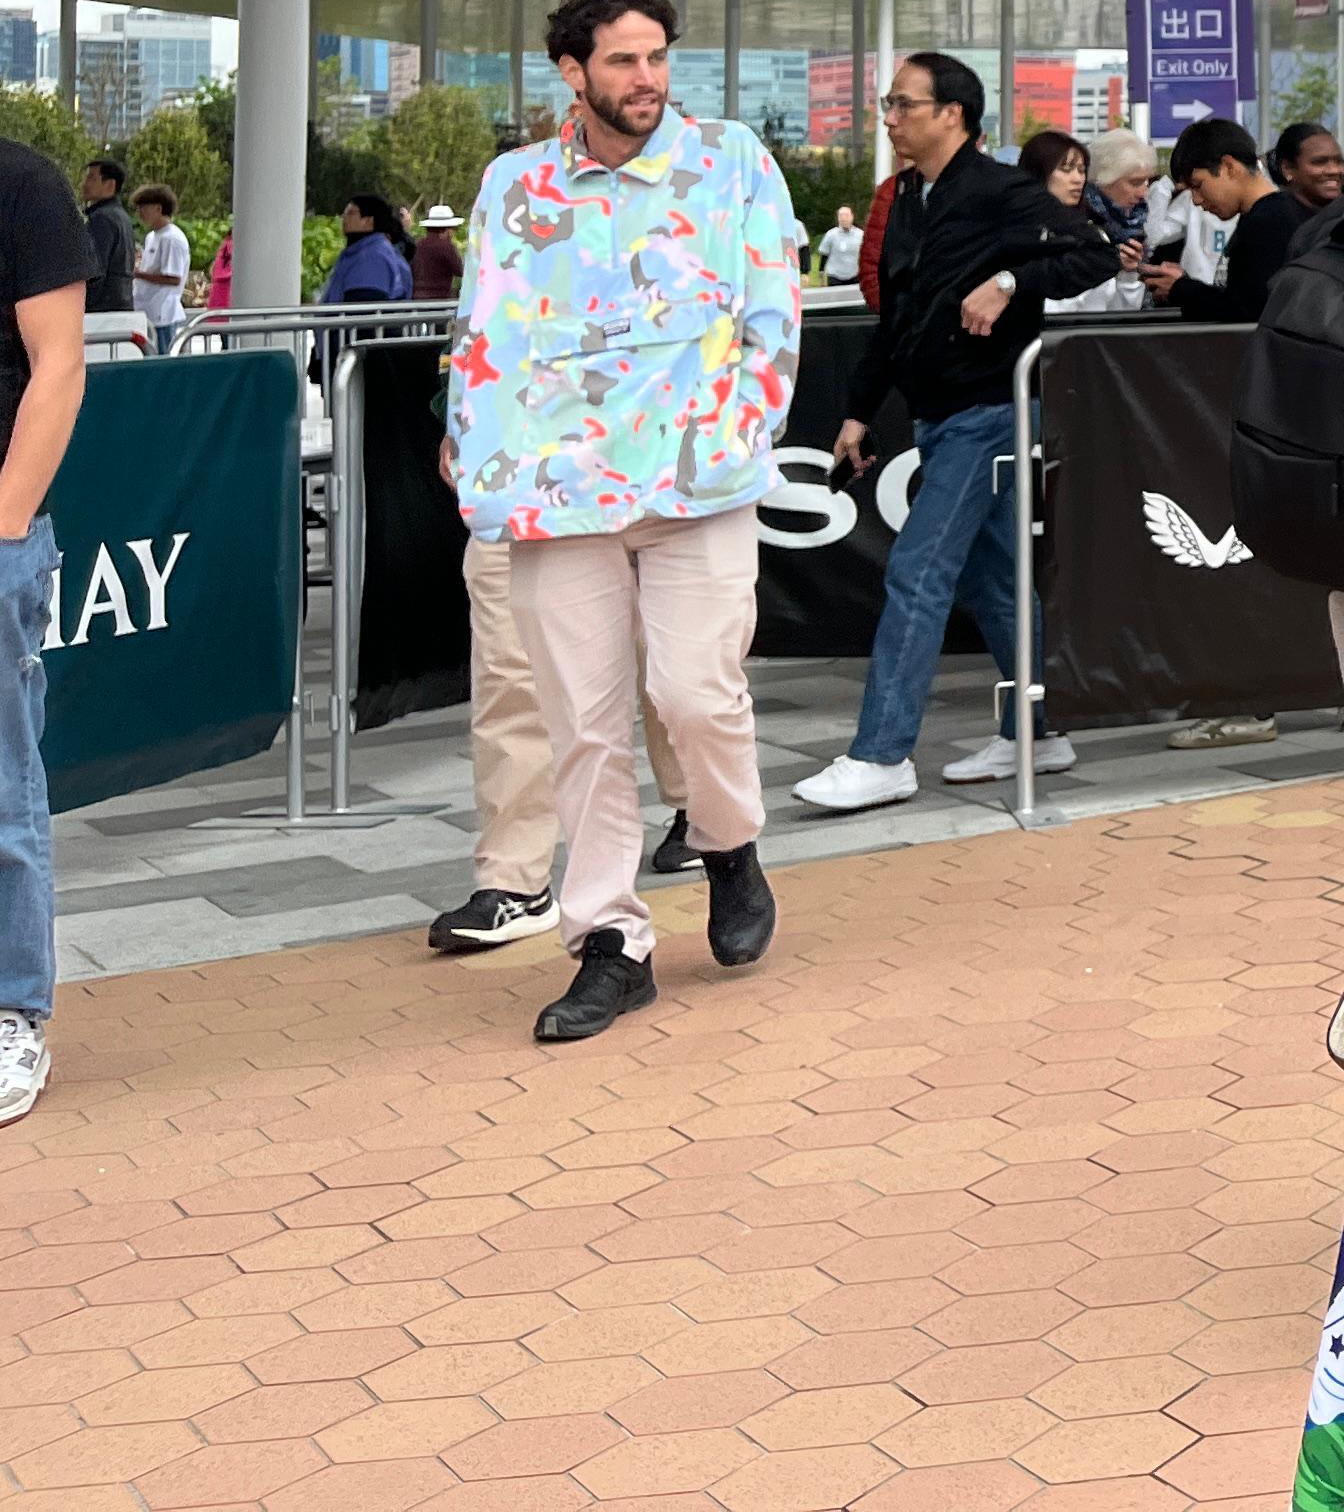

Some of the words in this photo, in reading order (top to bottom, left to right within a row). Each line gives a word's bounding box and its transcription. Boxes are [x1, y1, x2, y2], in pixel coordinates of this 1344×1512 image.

[1160, 7, 1223, 40] 出口
[1156, 58, 1189, 76] Exit
[1193, 58, 1229, 79] Only
